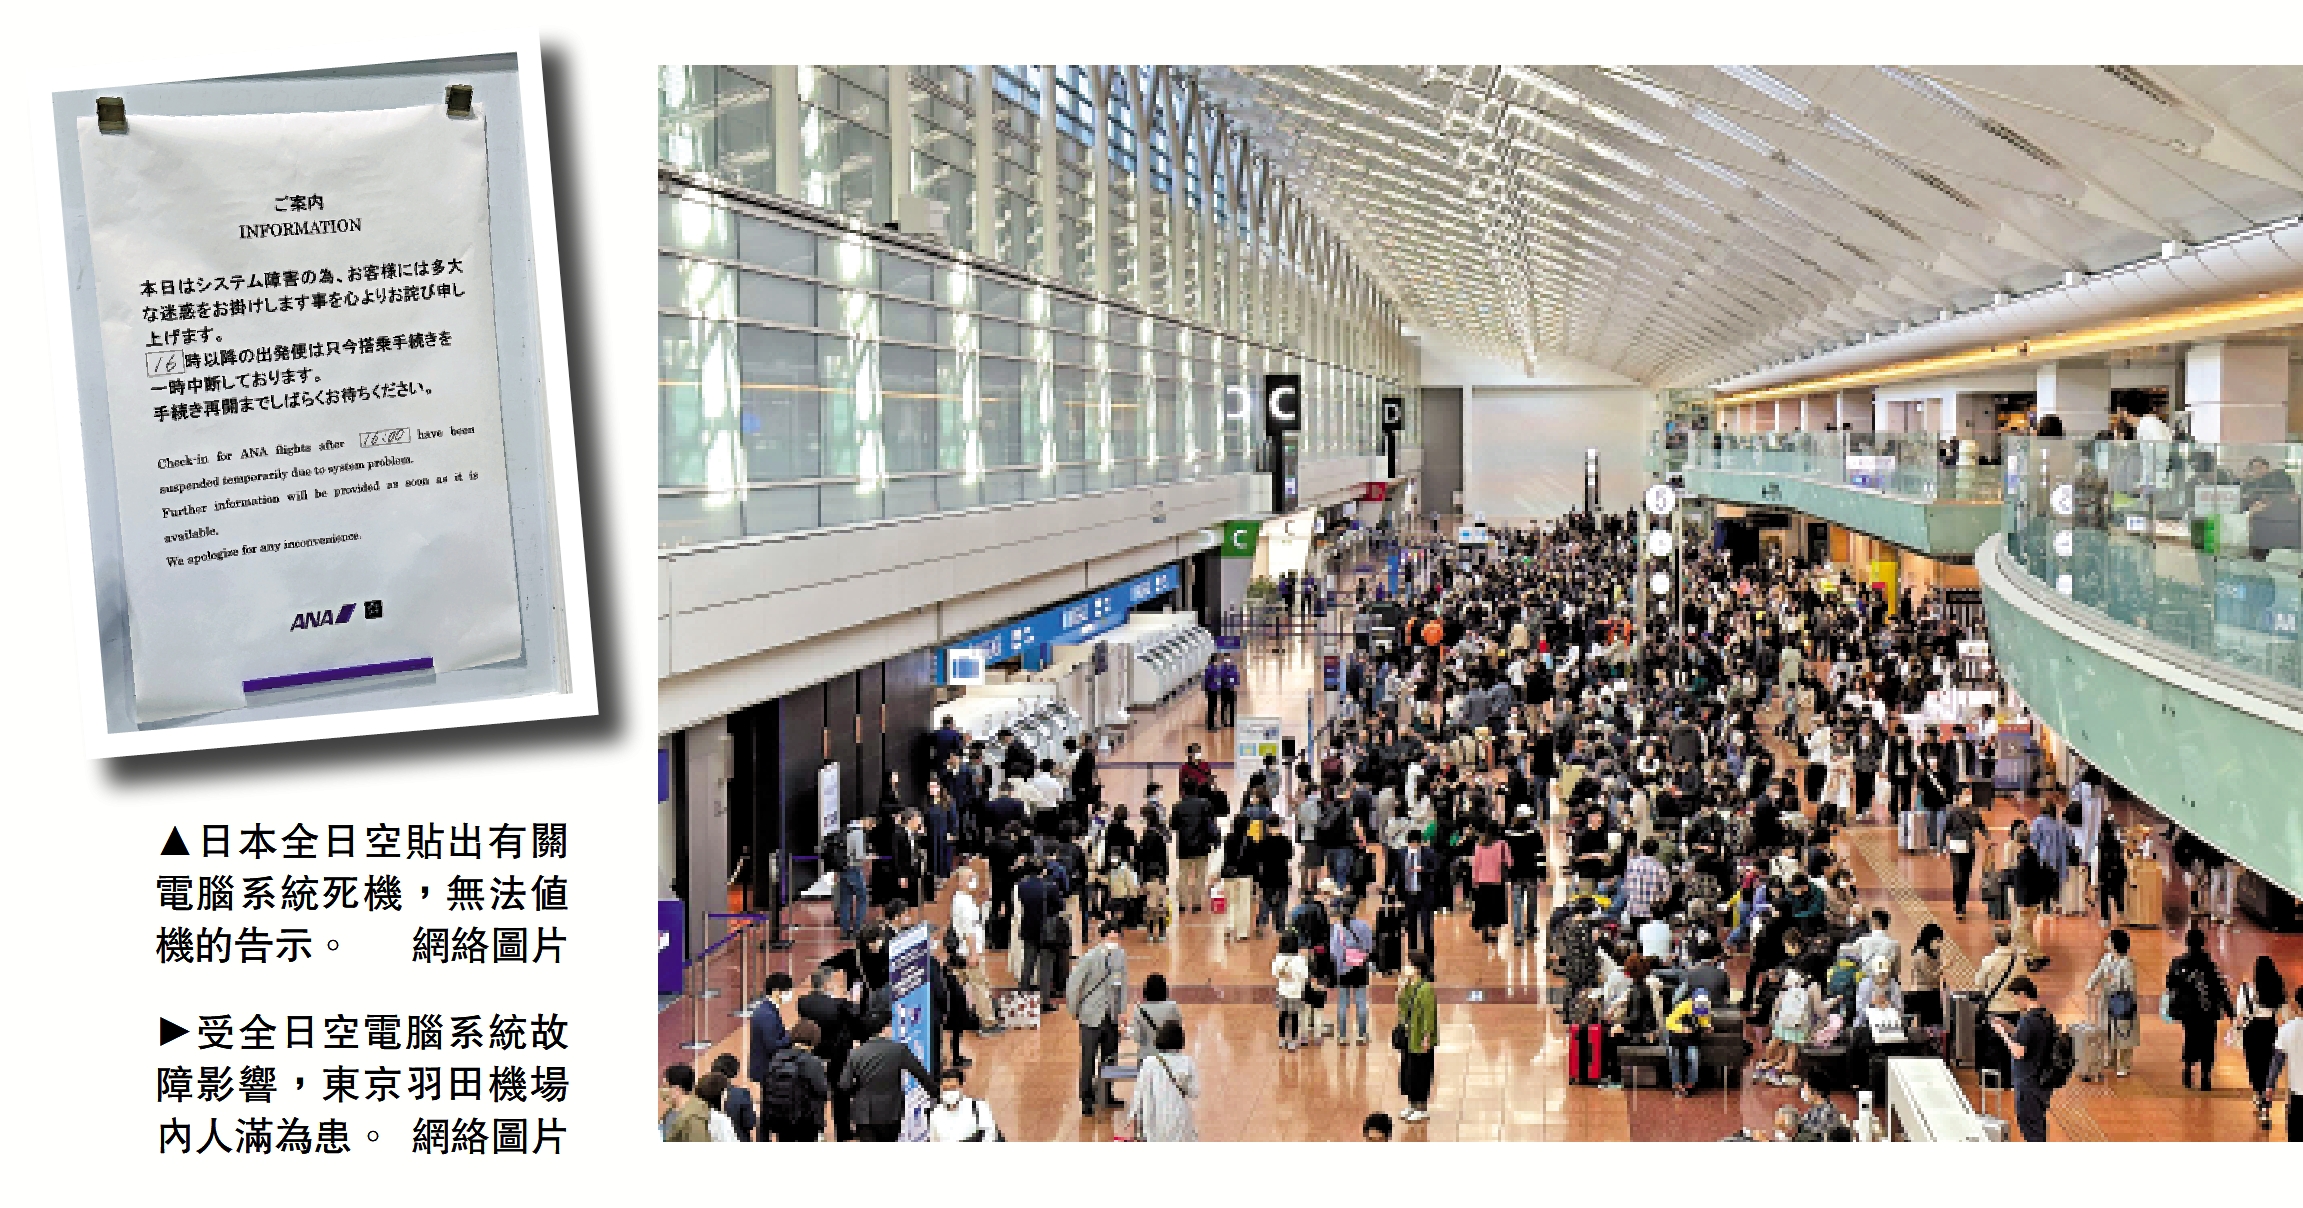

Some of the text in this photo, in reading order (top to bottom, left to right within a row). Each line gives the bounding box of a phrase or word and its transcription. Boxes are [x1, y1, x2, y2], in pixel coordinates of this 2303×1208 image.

[274, 193, 324, 212] ご案内
[239, 218, 362, 240] INFORMATION
[139, 258, 463, 297] 本日はシステム障害の為、お客様には多大
[146, 326, 223, 347] 上げます。
[150, 367, 322, 395] 一時中断しております。
[153, 381, 432, 422] 手続き再開までしばらくお待ちください。
[1269, 385, 1296, 421] C
[1385, 403, 1401, 424] D
[157, 453, 209, 469] Check-in
[216, 451, 233, 462] for
[240, 446, 269, 460] ANA
[275, 443, 312, 456] flights
[318, 440, 345, 451] after
[417, 429, 443, 440] have
[449, 426, 475, 436] been
[159, 455, 414, 494] suspended temporarily due to system problem.
[162, 470, 479, 518] Further information will be provided as soon as it is
[164, 526, 219, 543] available.
[1233, 529, 1248, 549] C
[166, 532, 362, 567] We apologize for any inconvenience.
[290, 609, 334, 632] ANA
